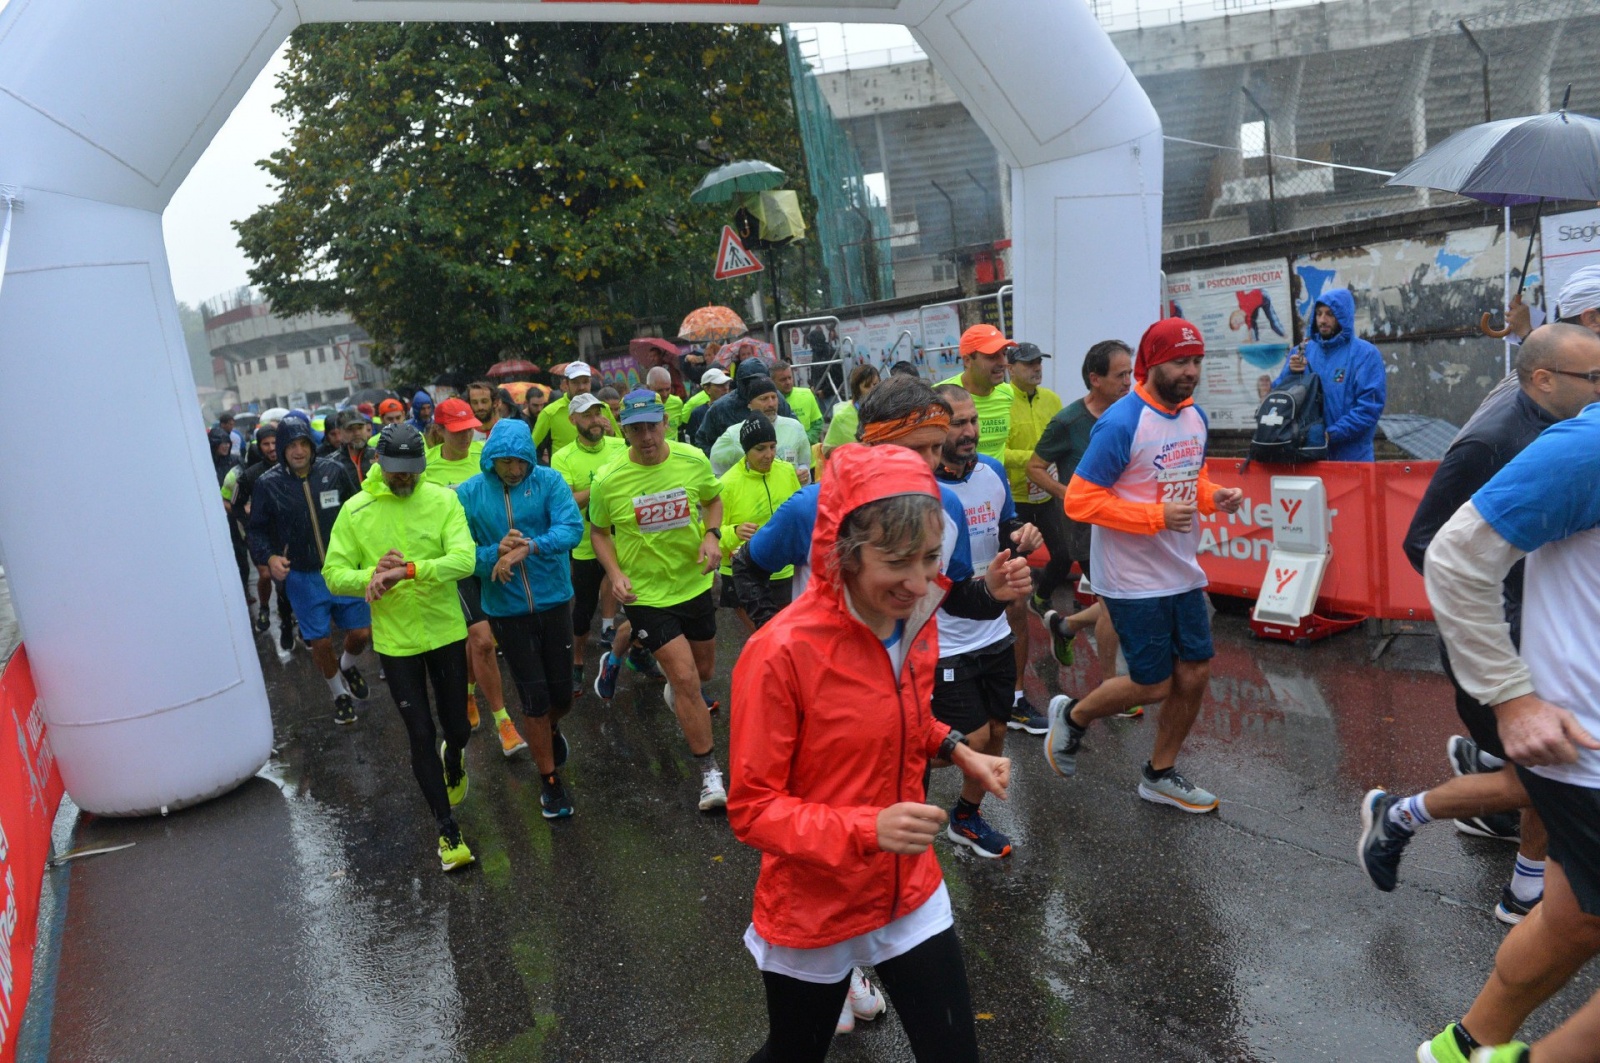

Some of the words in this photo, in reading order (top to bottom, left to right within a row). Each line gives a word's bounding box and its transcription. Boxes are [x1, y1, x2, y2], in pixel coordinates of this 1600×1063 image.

[1206, 270, 1283, 289] PSICOMOTRICITA'
[981, 425, 1007, 434] CITYRUN
[640, 500, 687, 524] 2287
[1198, 526, 1274, 561] Alon
